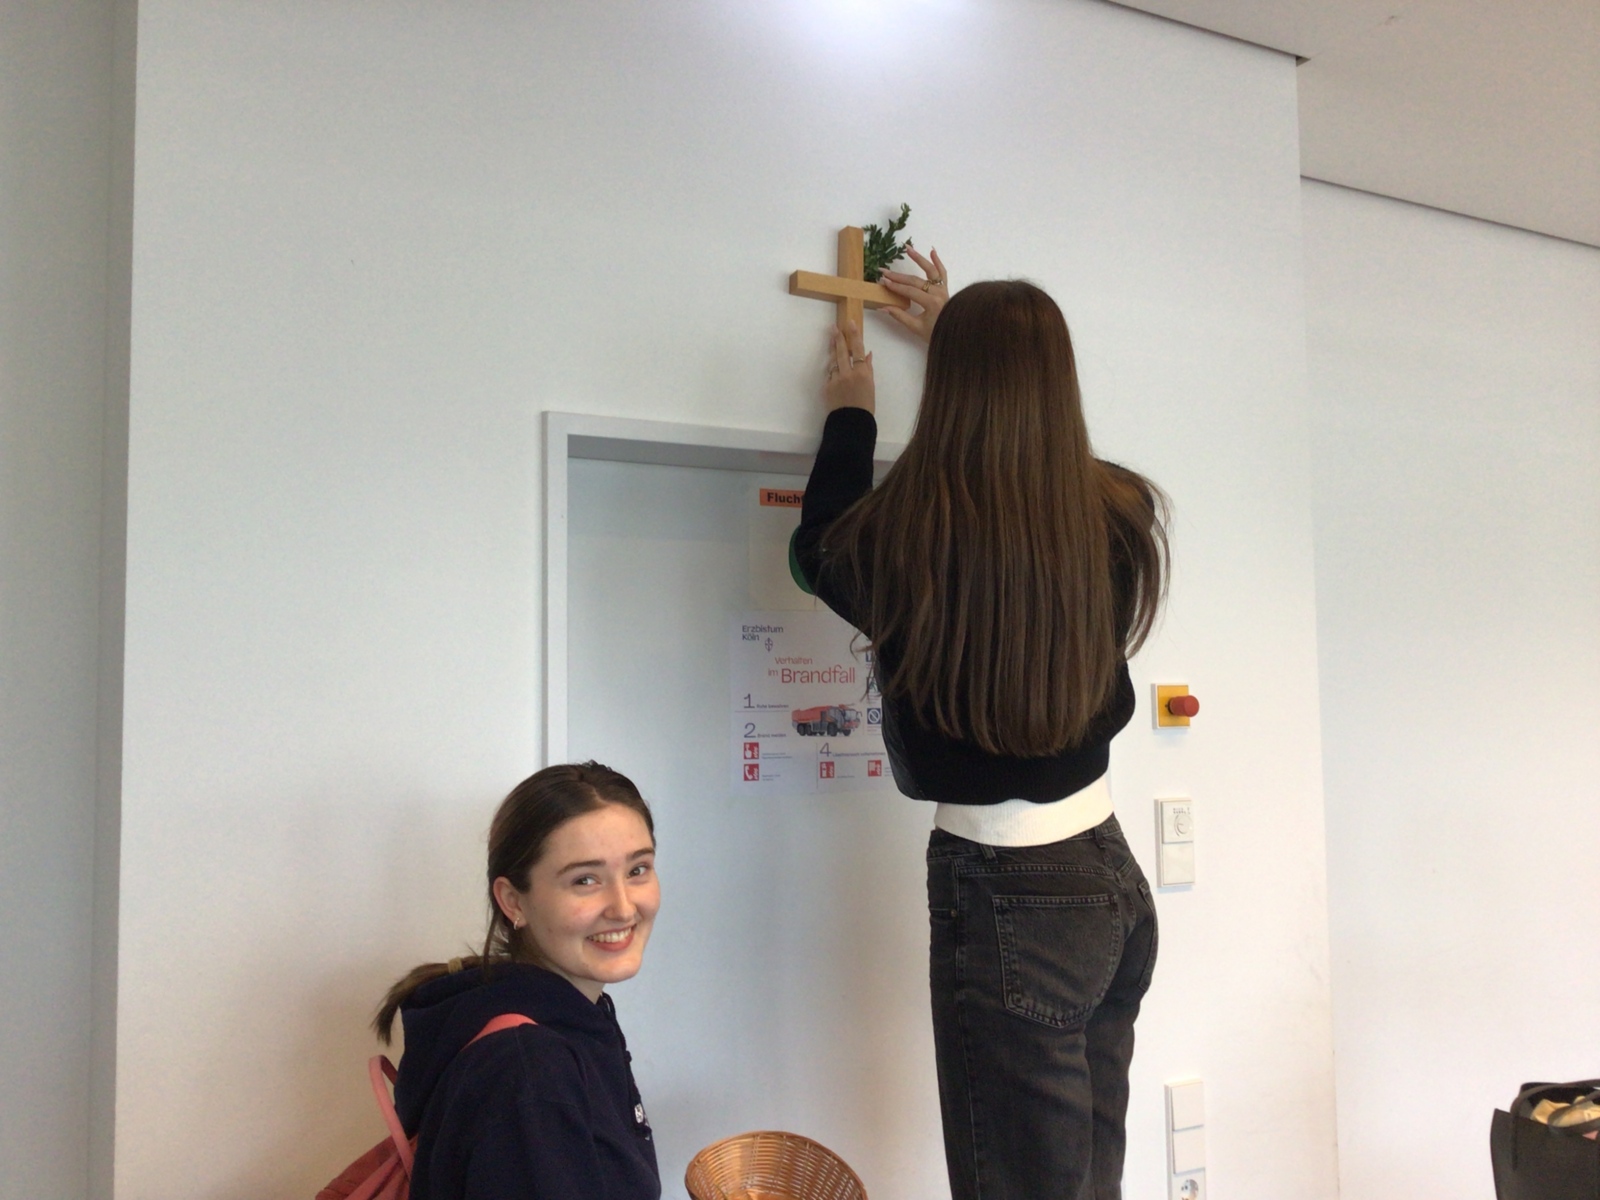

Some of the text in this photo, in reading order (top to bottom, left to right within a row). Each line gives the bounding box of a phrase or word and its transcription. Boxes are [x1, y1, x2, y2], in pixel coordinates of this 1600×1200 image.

[767, 492, 803, 504] Fluch
[741, 624, 784, 633] Erzbistum
[741, 633, 760, 641] Köln
[774, 656, 813, 665] Verhalten
[768, 664, 856, 684] im Brandfall
[743, 693, 756, 709] 1
[743, 722, 756, 738] 2
[819, 742, 832, 757] 4
